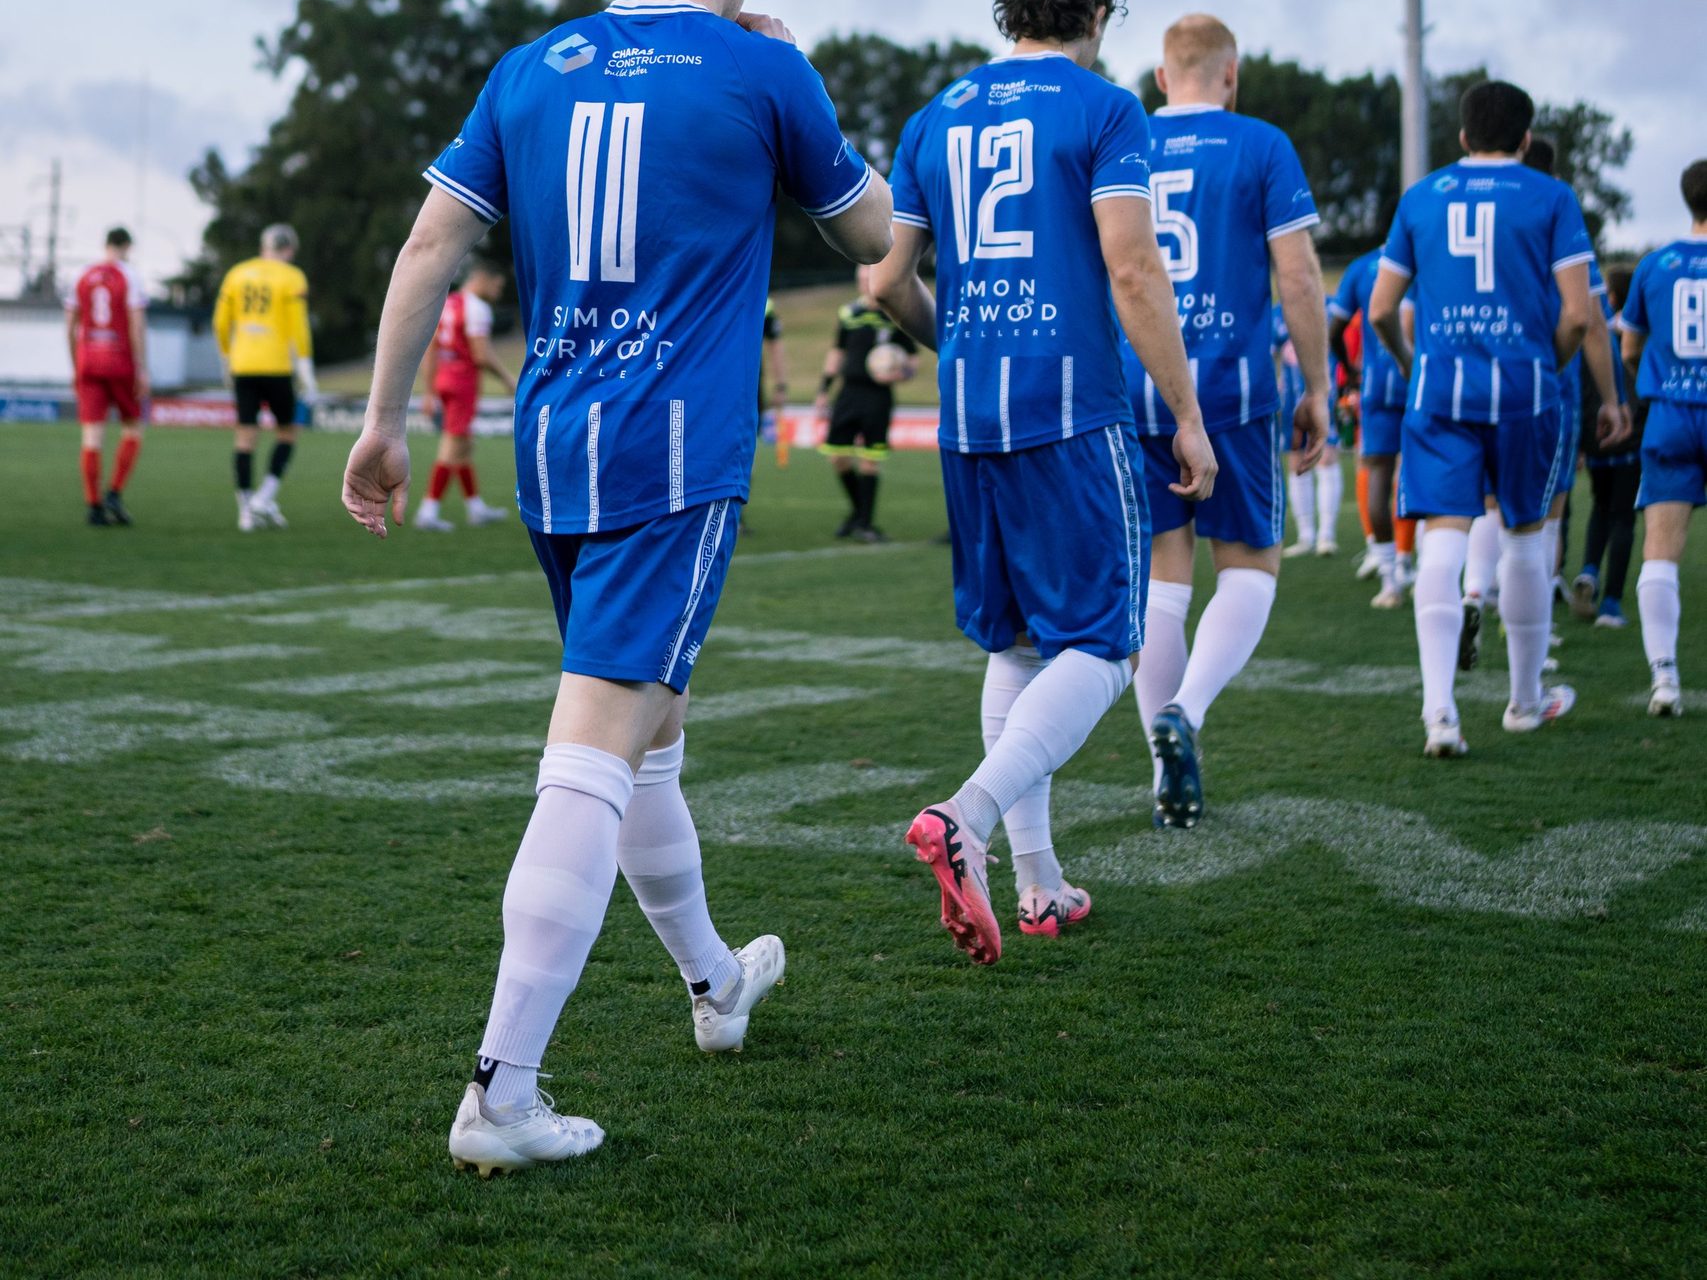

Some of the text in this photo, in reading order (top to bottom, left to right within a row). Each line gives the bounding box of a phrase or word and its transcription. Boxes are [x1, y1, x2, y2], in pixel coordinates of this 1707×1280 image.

[608, 54, 703, 69] CONSTRUCTIONS
[612, 47, 655, 59] CHARAS
[566, 101, 646, 283] 11
[947, 118, 1034, 264] 12
[1149, 168, 1199, 283] 5
[1447, 201, 1496, 293] 4
[554, 305, 658, 331] SIMON
[945, 303, 1058, 328] CRWOOD
[1442, 305, 1509, 320] SIMON
[1672, 277, 1707, 360] 8
